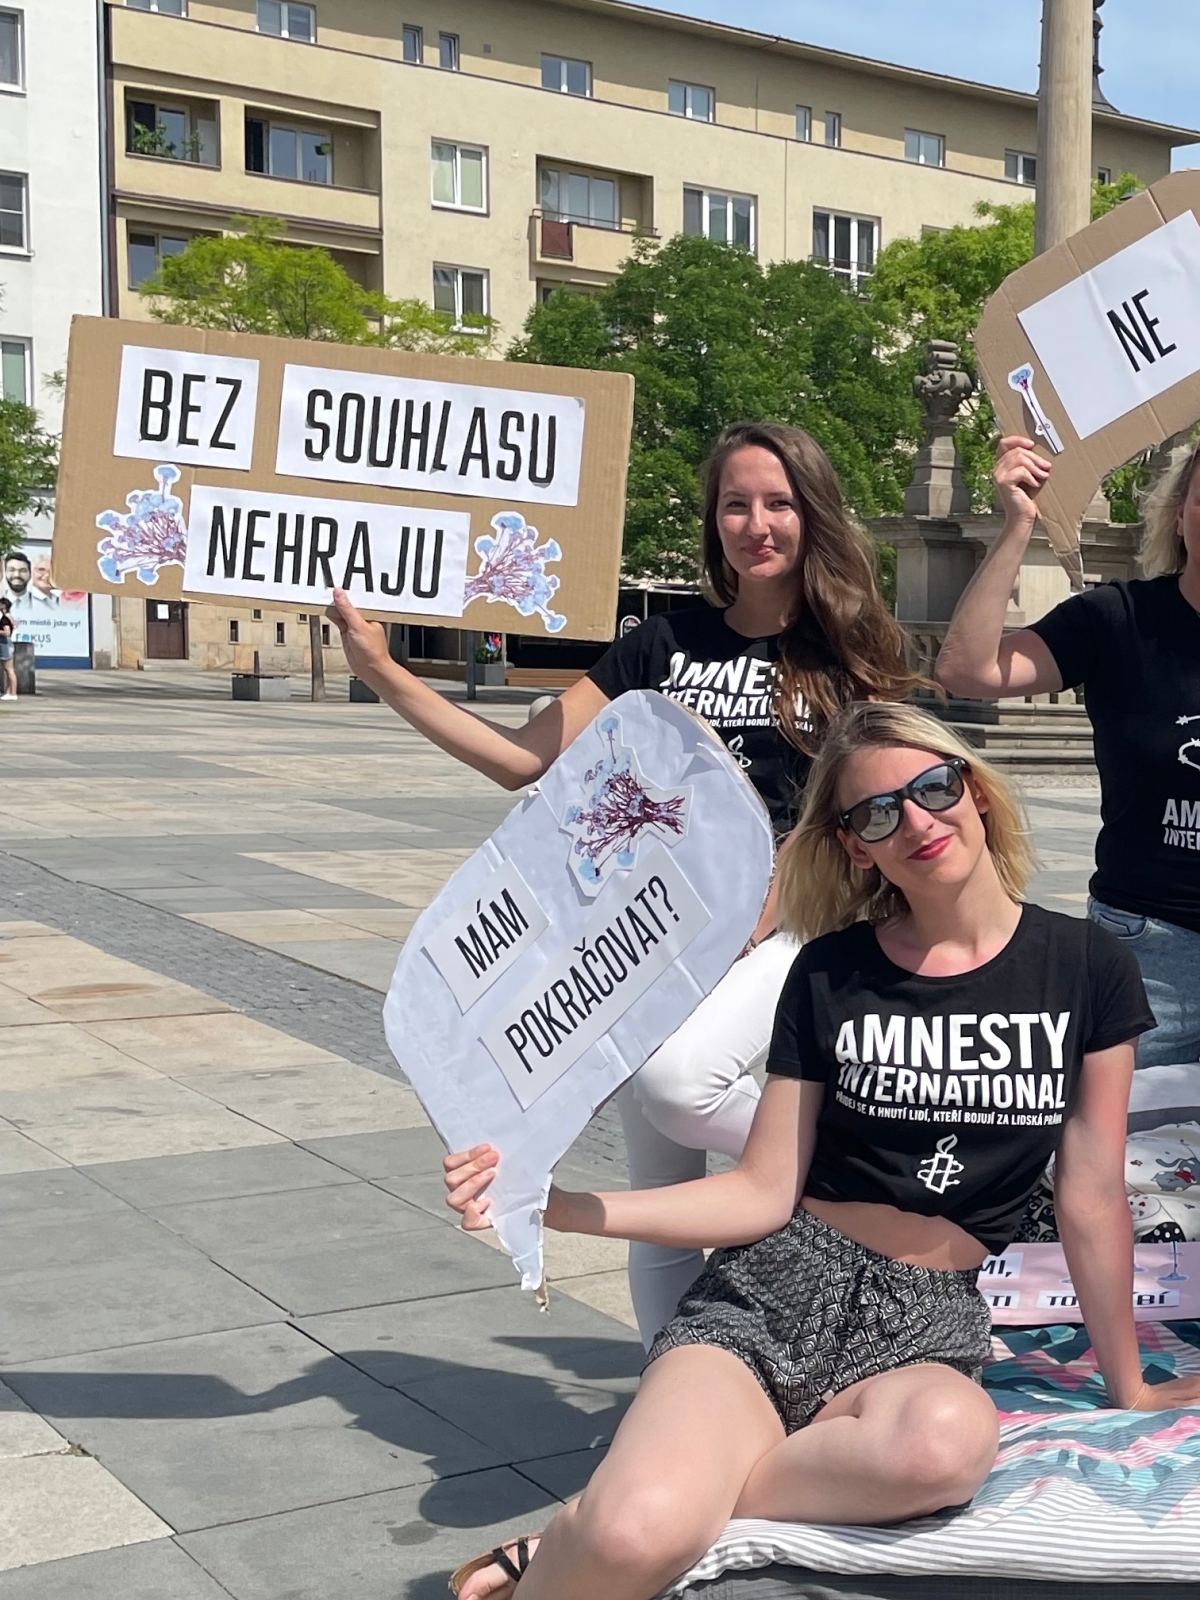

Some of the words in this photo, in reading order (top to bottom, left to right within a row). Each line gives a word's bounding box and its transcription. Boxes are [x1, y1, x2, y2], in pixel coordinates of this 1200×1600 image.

[1106, 288, 1177, 373] NE
[138, 367, 243, 451] BEZ
[303, 388, 557, 485] SOUHLASU
[205, 505, 444, 599] NEHRAJU
[453, 888, 530, 979] MÁM
[504, 875, 683, 1074] POKRAČOVAT?
[835, 1011, 1071, 1071] AMNESTY
[837, 1062, 1066, 1110] INTERNATIONAL
[857, 1102, 868, 1115] SE
[869, 1105, 876, 1117] K
[877, 1106, 908, 1120] HNUTÍ
[908, 1107, 931, 1123] LIDÍ,
[933, 1109, 962, 1123] KTEŘÍ
[963, 1111, 996, 1125] BOJUJÍ
[996, 1113, 1010, 1125] ZA
[1011, 1112, 1043, 1126] LIDSKÁ
[989, 1294, 1012, 1307] TI
[1046, 1295, 1077, 1307] TO
